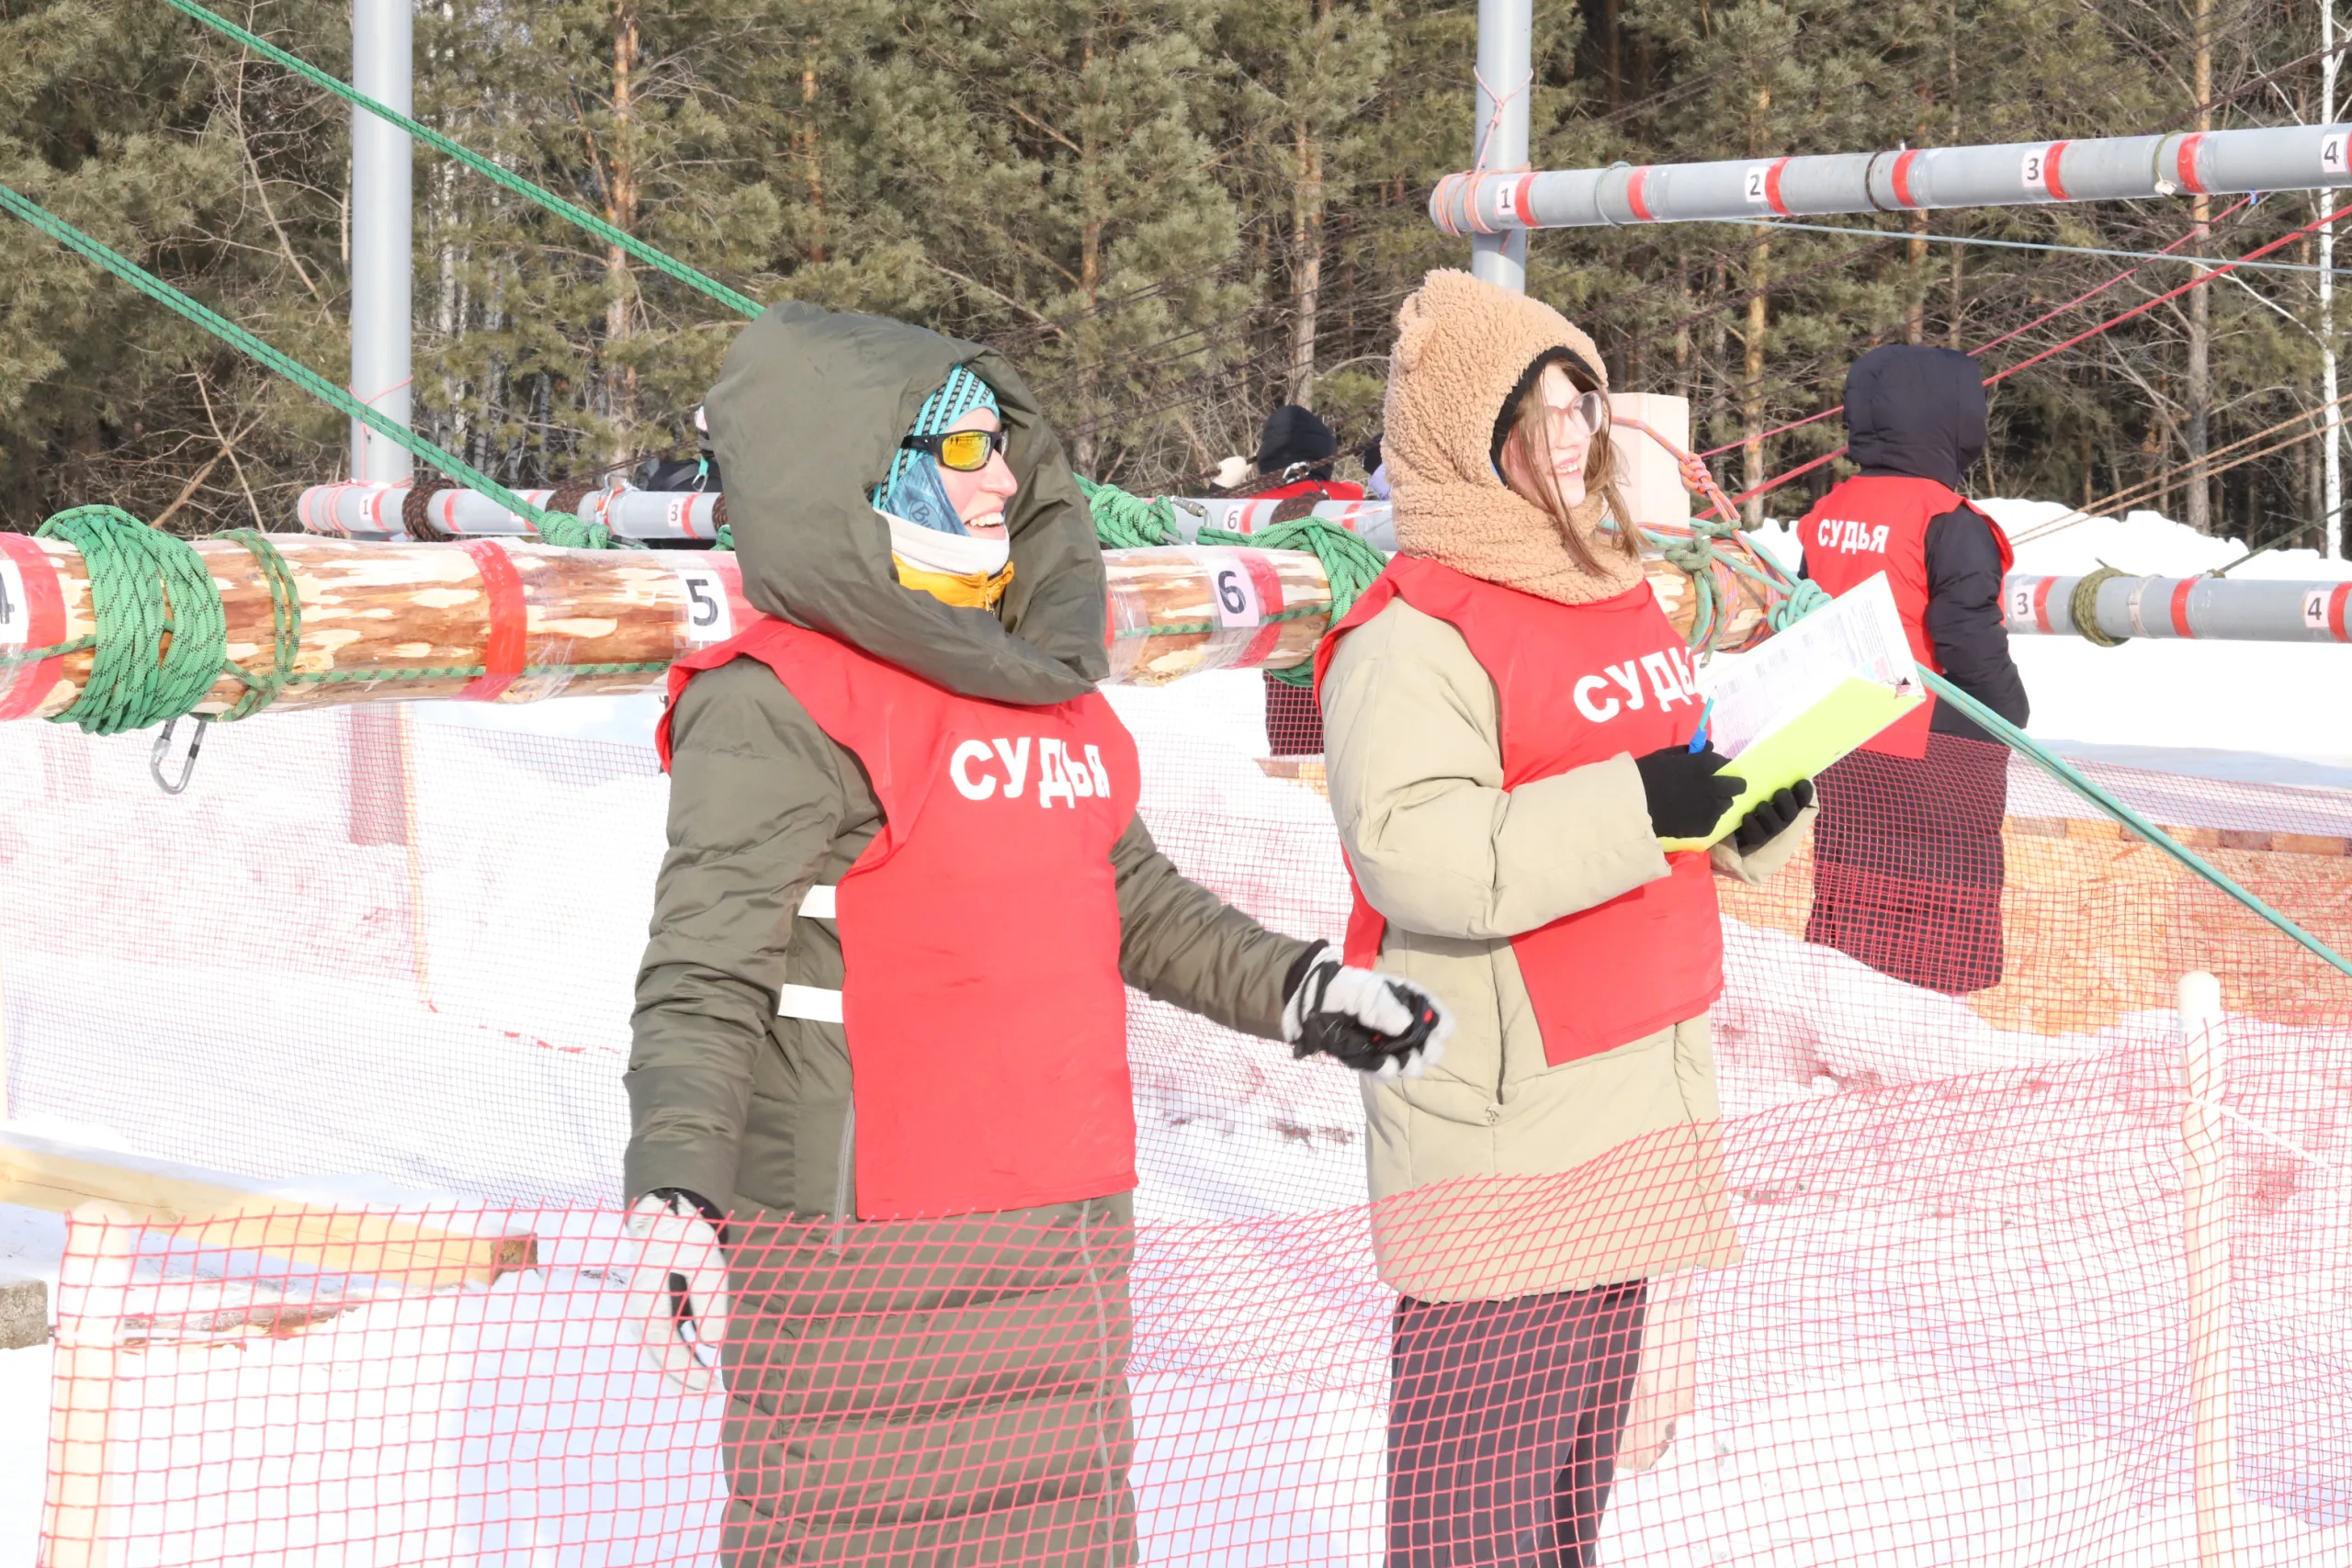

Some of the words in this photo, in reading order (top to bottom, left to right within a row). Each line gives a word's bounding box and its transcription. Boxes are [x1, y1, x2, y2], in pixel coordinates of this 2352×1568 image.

[2324, 141, 2339, 164] 4
[2026, 157, 2040, 181] 3
[1749, 173, 1761, 196] 2
[1500, 187, 1511, 209] 1
[362, 499, 369, 515] 1
[671, 503, 679, 522] 3
[1227, 510, 1238, 530] 6
[1817, 518, 1890, 555] СУДЬЯ
[685, 579, 718, 626] 5
[1217, 570, 1247, 615] 6
[2016, 592, 2029, 615] 3
[2307, 597, 2322, 621] 4
[1573, 646, 1695, 723] СУДЬ
[949, 737, 1110, 808] СУДЬЯ
